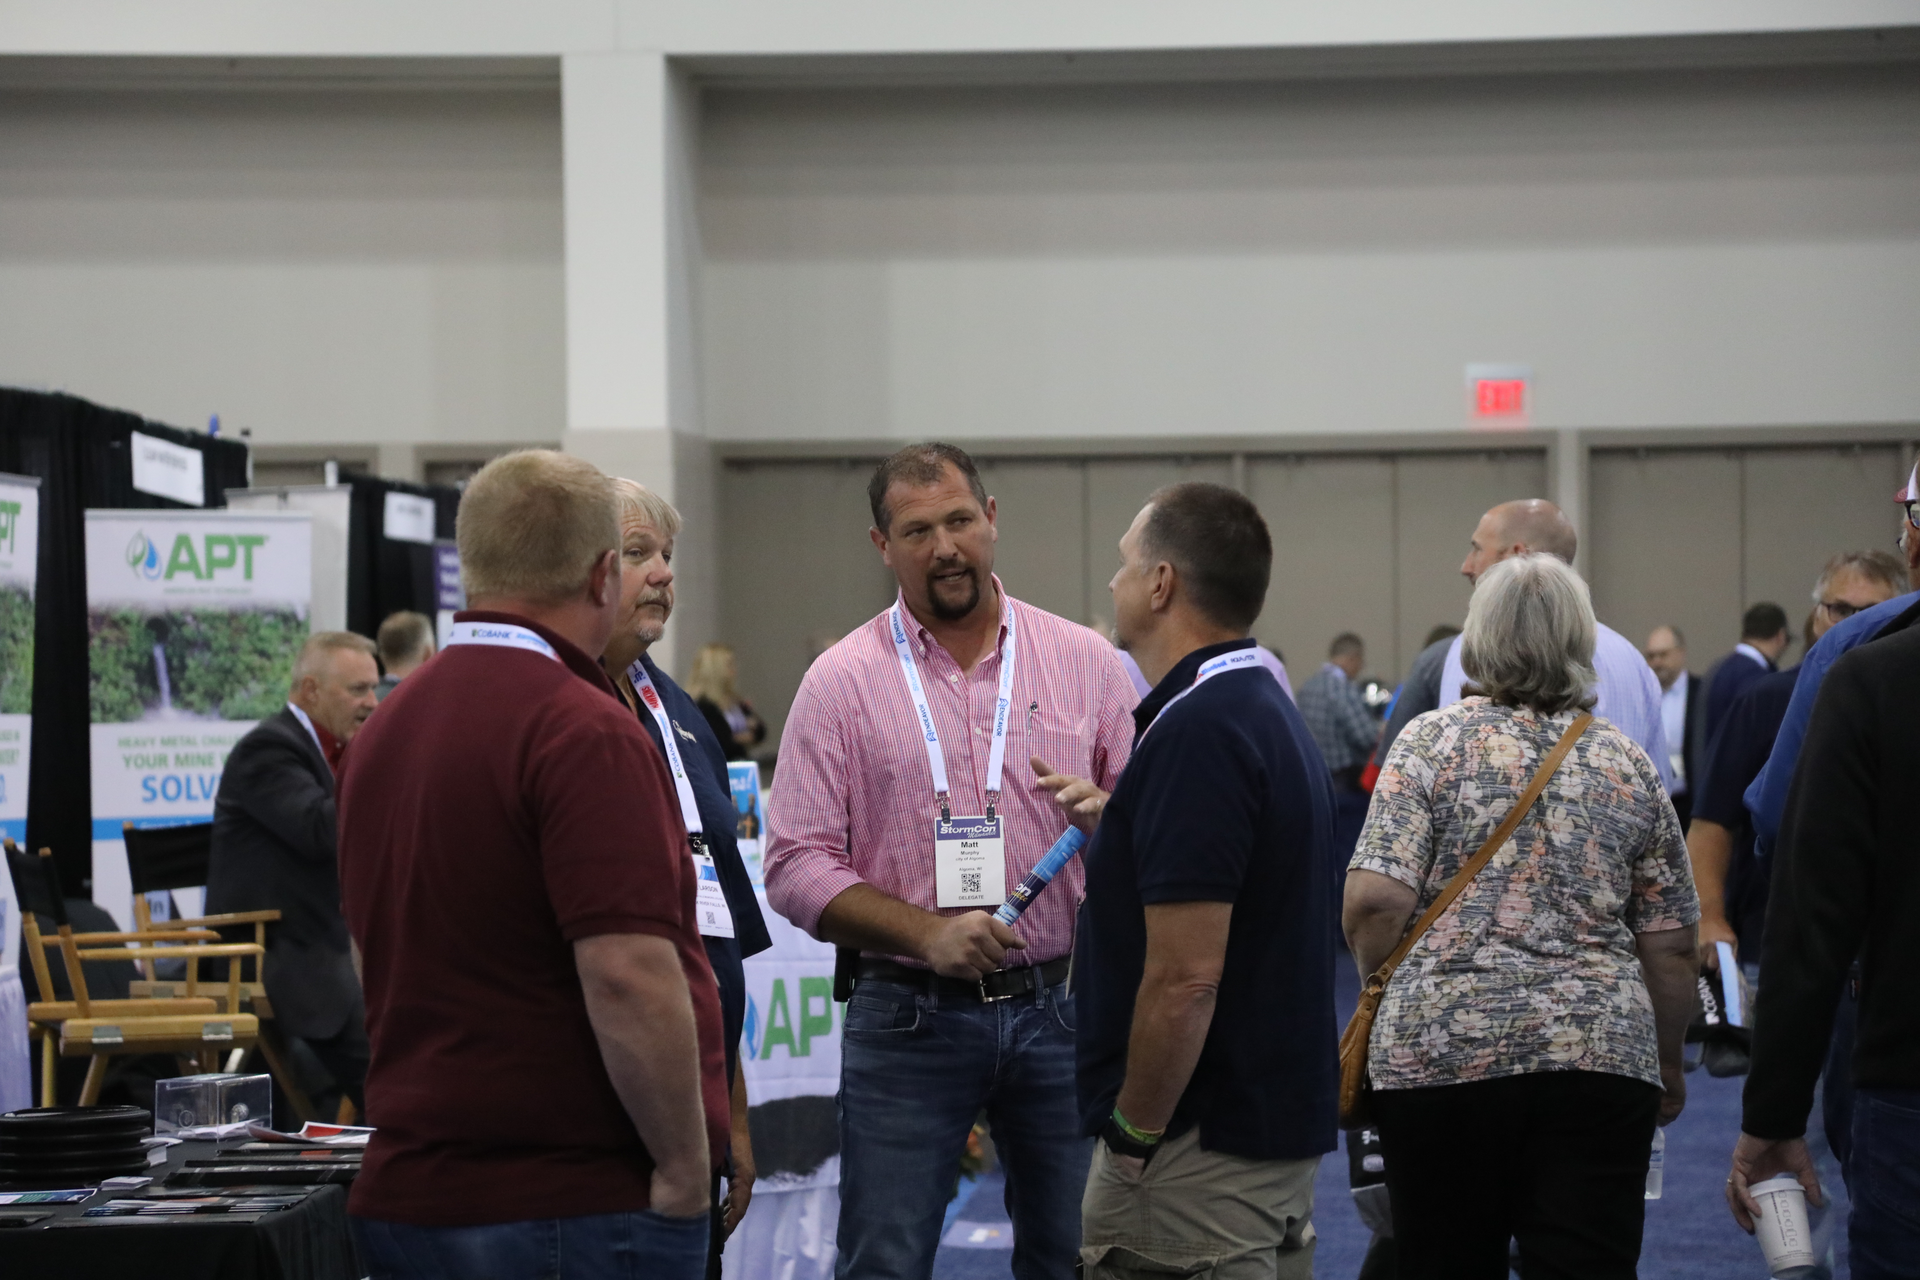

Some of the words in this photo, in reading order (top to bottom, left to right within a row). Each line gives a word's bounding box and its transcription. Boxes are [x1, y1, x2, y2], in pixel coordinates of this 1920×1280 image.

[1477, 379, 1525, 413] EXIT
[0, 500, 22, 554] PT
[163, 532, 266, 581] APT
[919, 703, 933, 733] ENDEAVOR
[996, 707, 1006, 737] ENDEAVOR
[122, 753, 169, 769] YOUR
[174, 753, 215, 768] MINE
[141, 773, 221, 803] SOLV
[940, 825, 996, 834] StormCon
